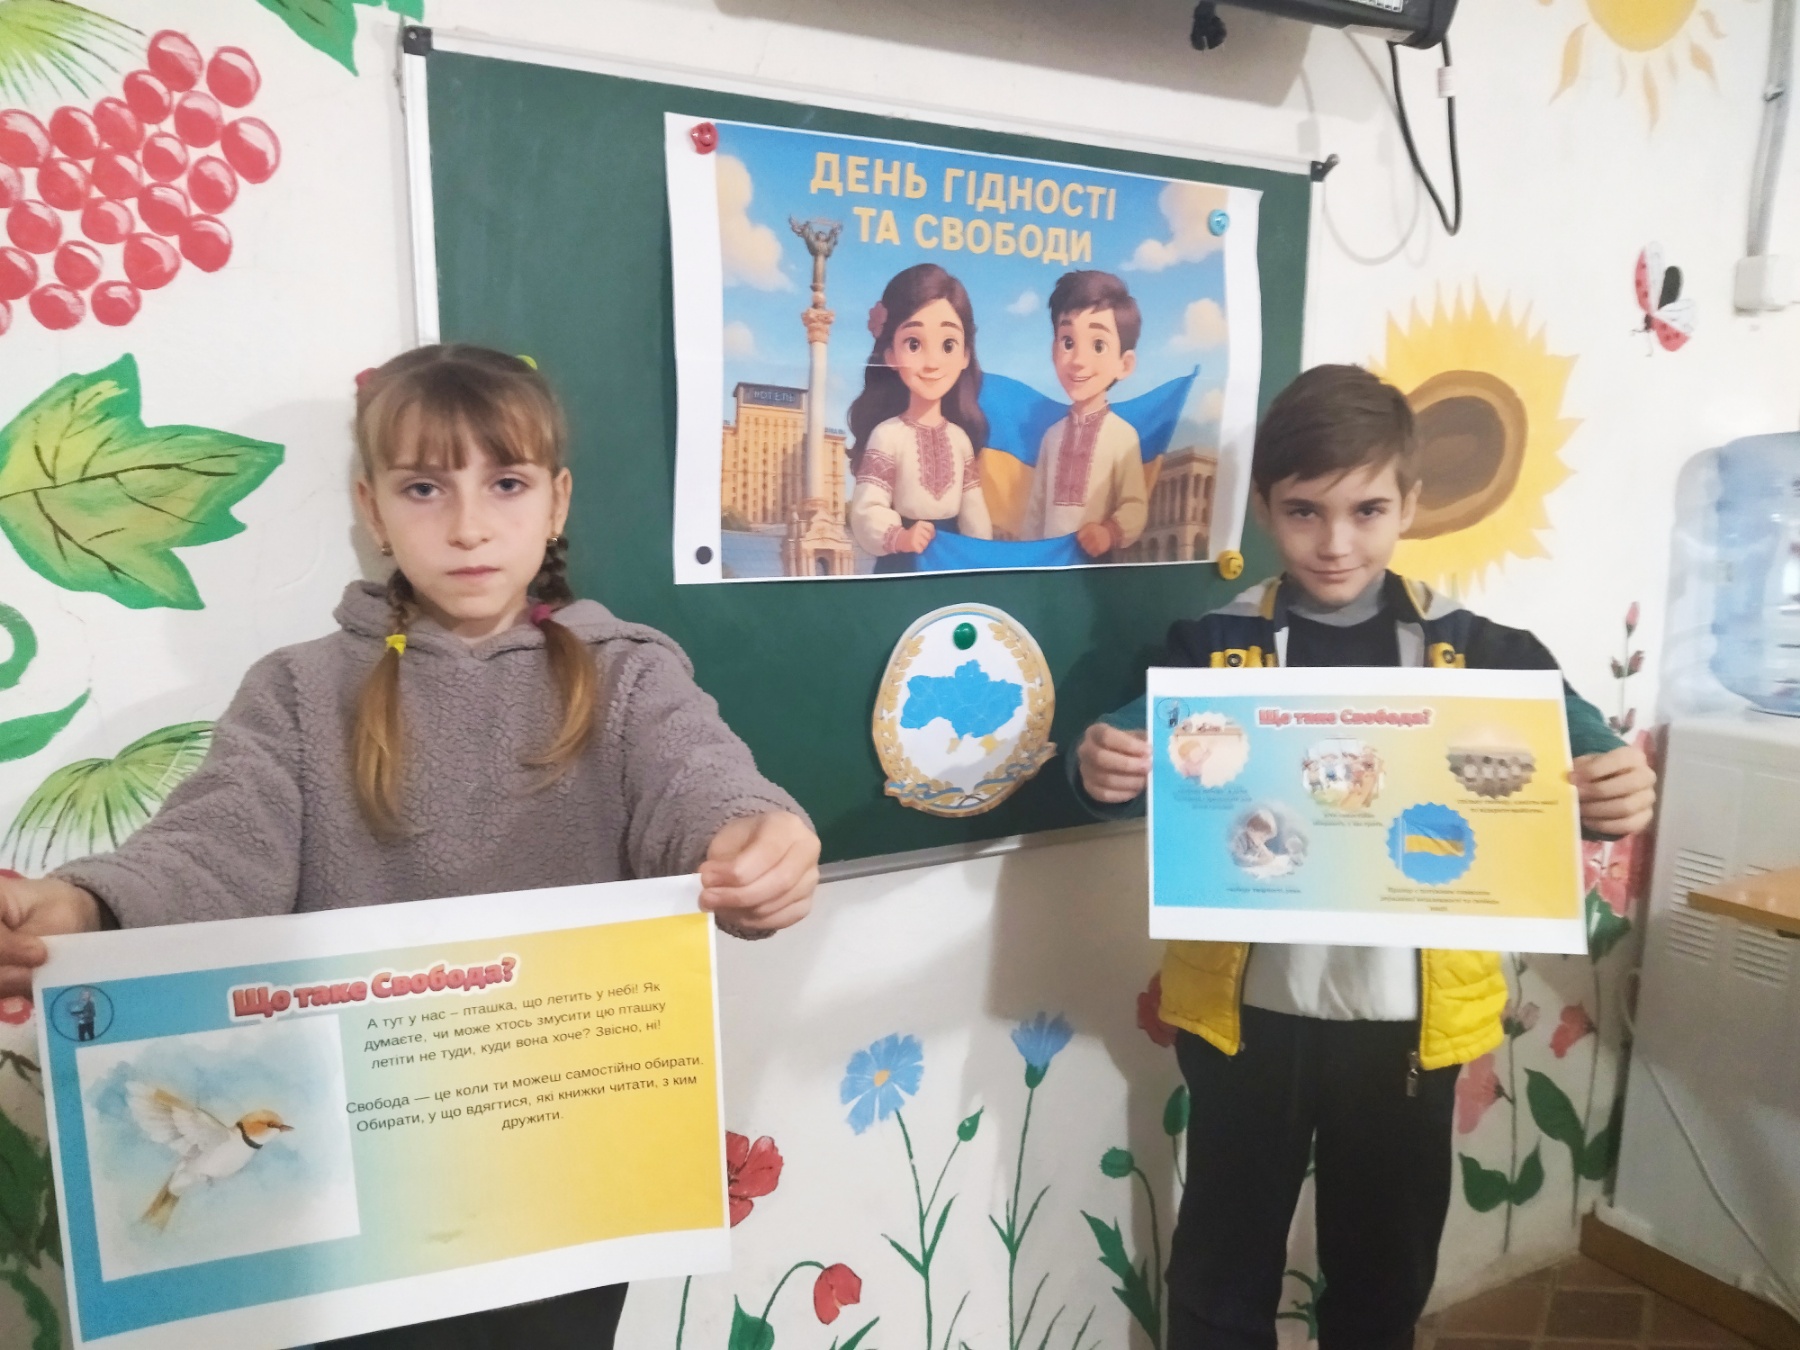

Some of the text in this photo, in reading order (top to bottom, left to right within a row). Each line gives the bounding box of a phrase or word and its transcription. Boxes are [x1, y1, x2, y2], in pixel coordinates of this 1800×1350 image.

[810, 151, 1117, 221] ДЕНЬ ГІДНОСТІ
[852, 206, 1092, 266] ТА СВОБОДИ
[1258, 709, 1433, 728] Що таке Свобода?
[232, 956, 517, 1018] Що таке Свобода?
[367, 1018, 378, 1030] А
[382, 1017, 404, 1030] тут
[408, 1015, 417, 1027] у
[421, 1011, 446, 1022] нас
[463, 1002, 517, 1016] пташка,
[522, 998, 543, 1009] що
[547, 992, 592, 1005] летить
[596, 990, 604, 1001] у
[608, 984, 638, 997] небі!
[643, 982, 661, 993] Як
[364, 1002, 666, 1052] думаєте, чи може хтось змусити цю пташку
[371, 1019, 661, 1069] летіти не туди, куди вона хоче? Звісно, ні!
[345, 1096, 410, 1114] Свобода
[434, 1090, 451, 1102] це
[455, 1083, 489, 1097] коли
[493, 1081, 508, 1091] ти
[512, 1073, 561, 1088] можеш
[565, 1061, 641, 1080] самостійно
[644, 1057, 704, 1070] обирати.
[356, 1076, 697, 1132] Обирати, у що вдягтися, які книжки читати, з ким
[501, 1110, 564, 1131] дружити.
